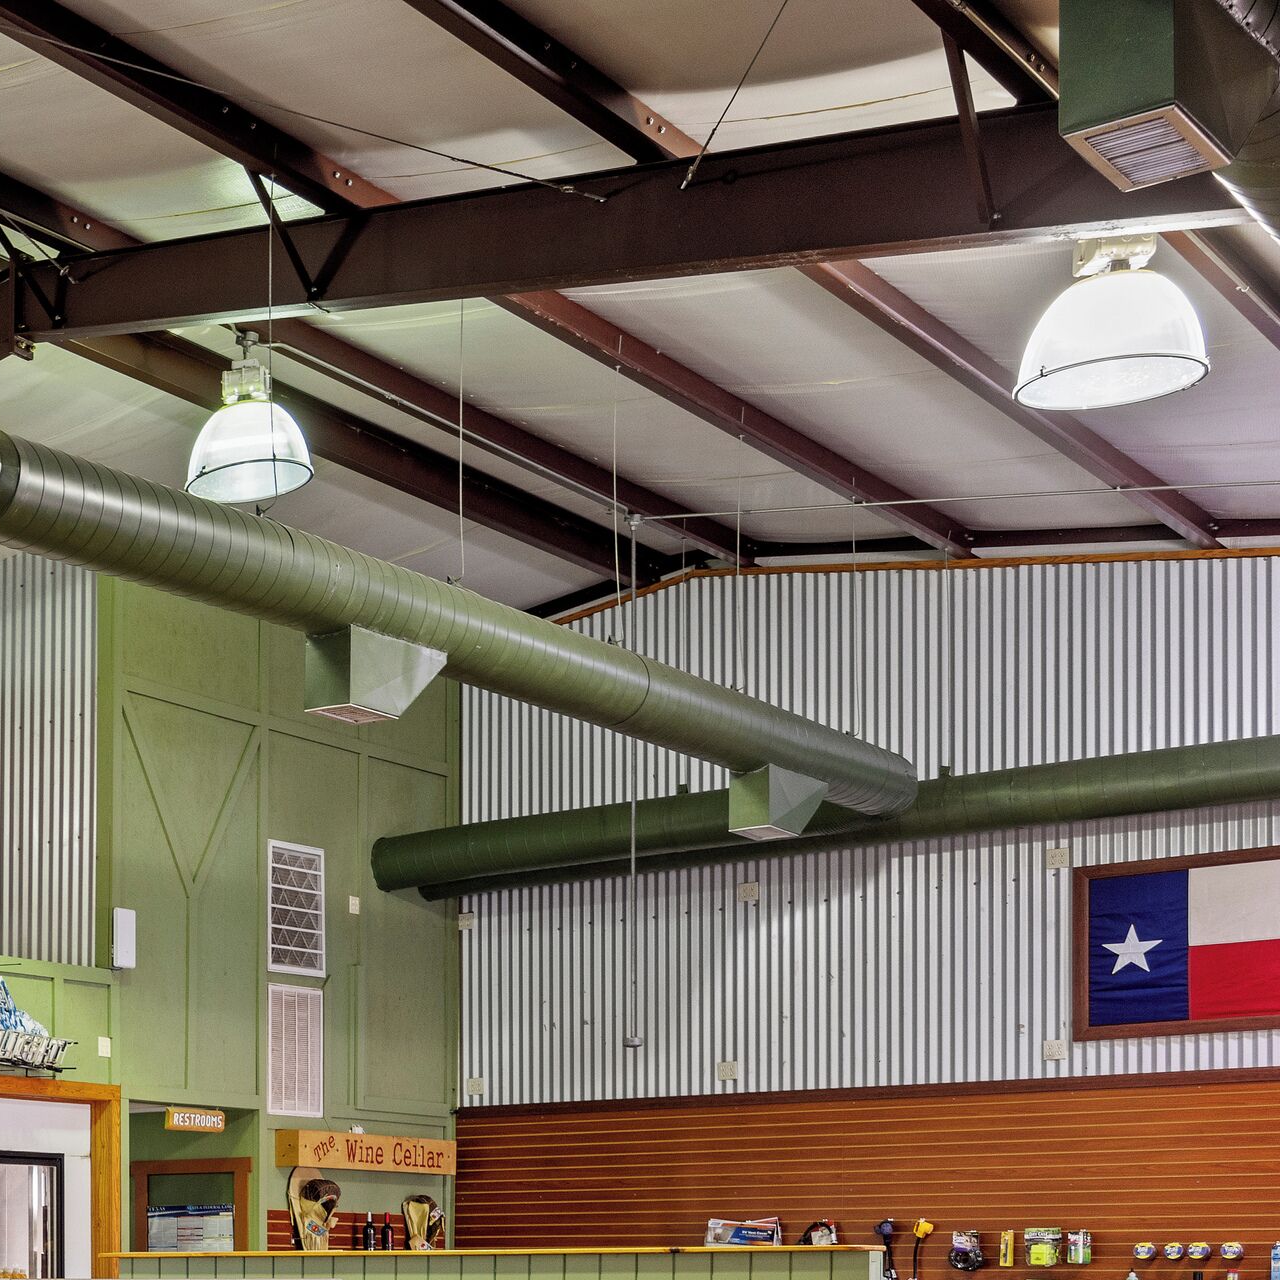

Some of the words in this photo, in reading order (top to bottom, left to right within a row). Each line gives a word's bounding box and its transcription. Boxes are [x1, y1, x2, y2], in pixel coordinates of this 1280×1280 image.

[173, 1111, 223, 1128] RESTROOMS
[313, 1135, 336, 1162] The
[346, 1139, 384, 1165] Wine
[392, 1142, 444, 1169] Cellar
